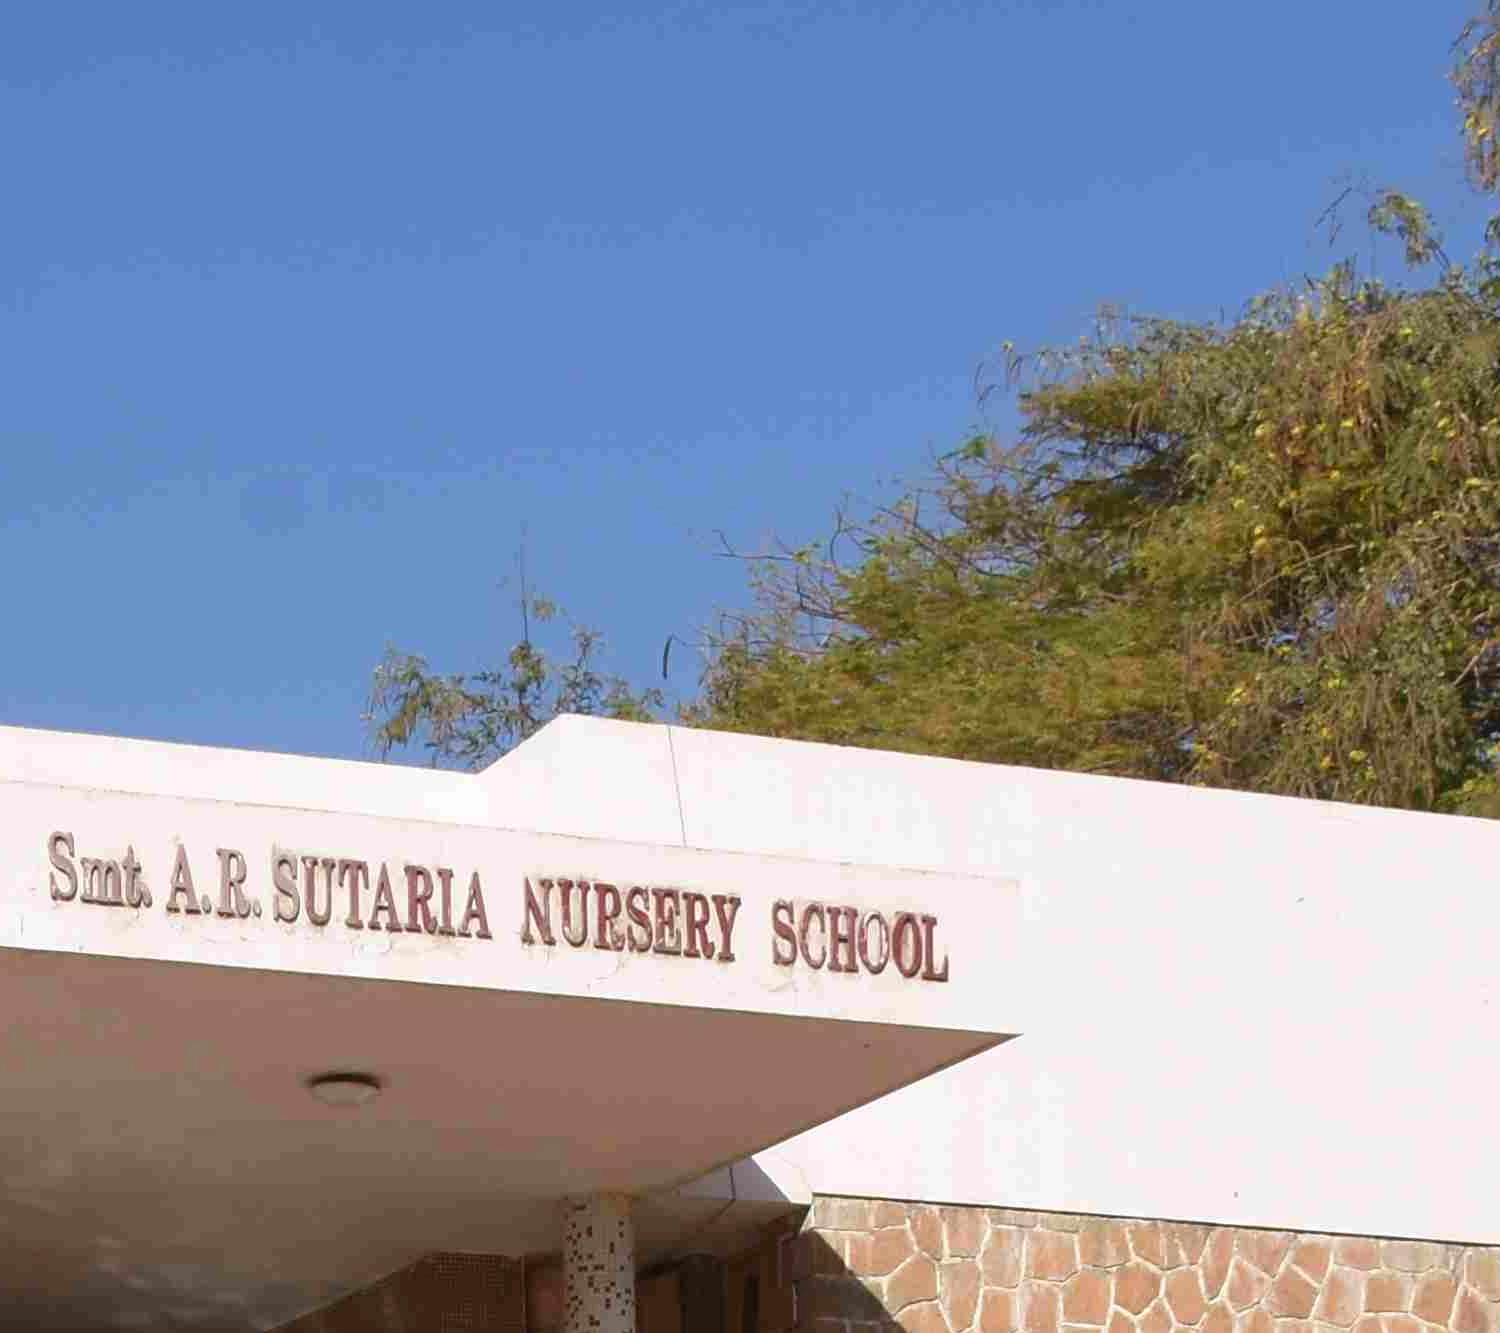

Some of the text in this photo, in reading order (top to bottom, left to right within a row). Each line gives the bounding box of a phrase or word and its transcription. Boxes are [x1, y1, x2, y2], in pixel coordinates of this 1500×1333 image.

[272, 847, 493, 940] SUTARIA
[520, 877, 742, 962] NURSERY
[772, 899, 949, 982] SCHOOL
